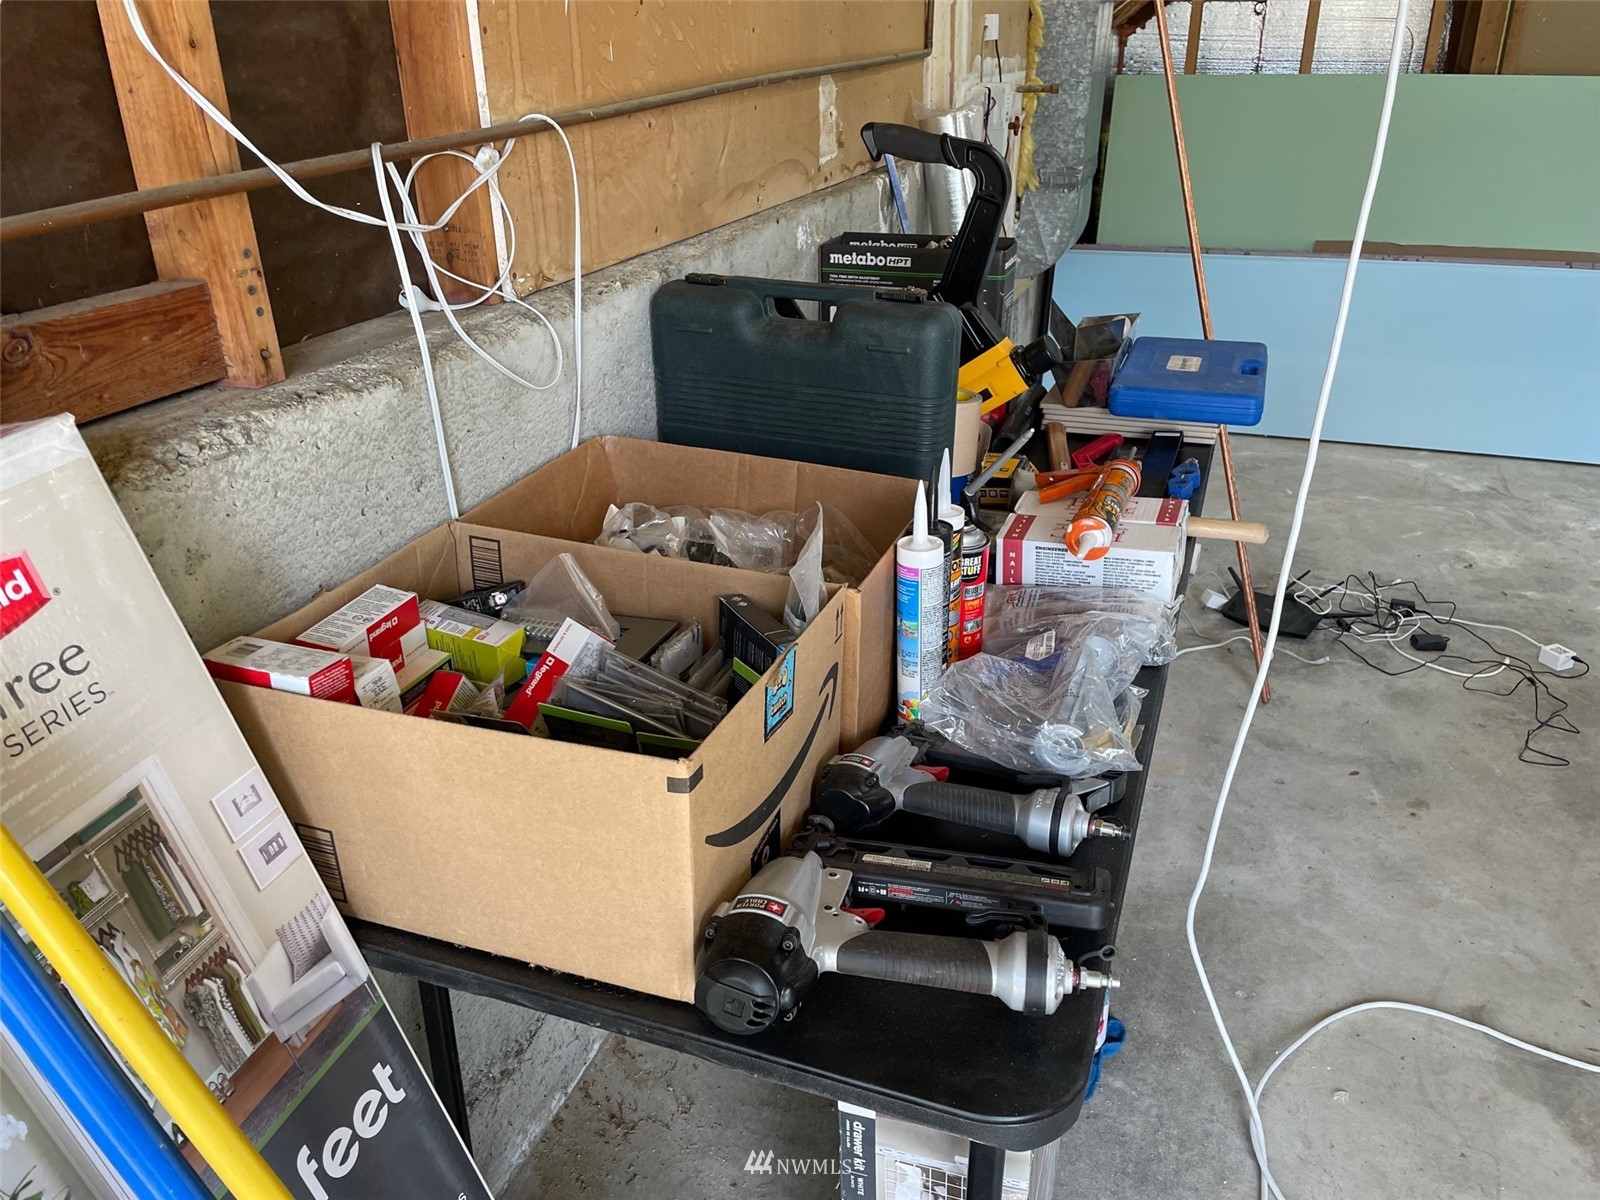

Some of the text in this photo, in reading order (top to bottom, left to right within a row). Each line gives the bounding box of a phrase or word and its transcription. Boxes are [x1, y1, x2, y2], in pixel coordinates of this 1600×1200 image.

[829, 252, 911, 267] metabo HPT
[961, 555, 982, 567] GREAT
[961, 565, 982, 576] STUFF
[369, 622, 393, 642] legrand
[0, 644, 90, 720] ree
[526, 664, 550, 698] legrand
[3, 681, 107, 758] SERIES
[296, 1062, 406, 1200] feet
[853, 1121, 866, 1171] drawer kit
[857, 1177, 865, 1196] WHITE
